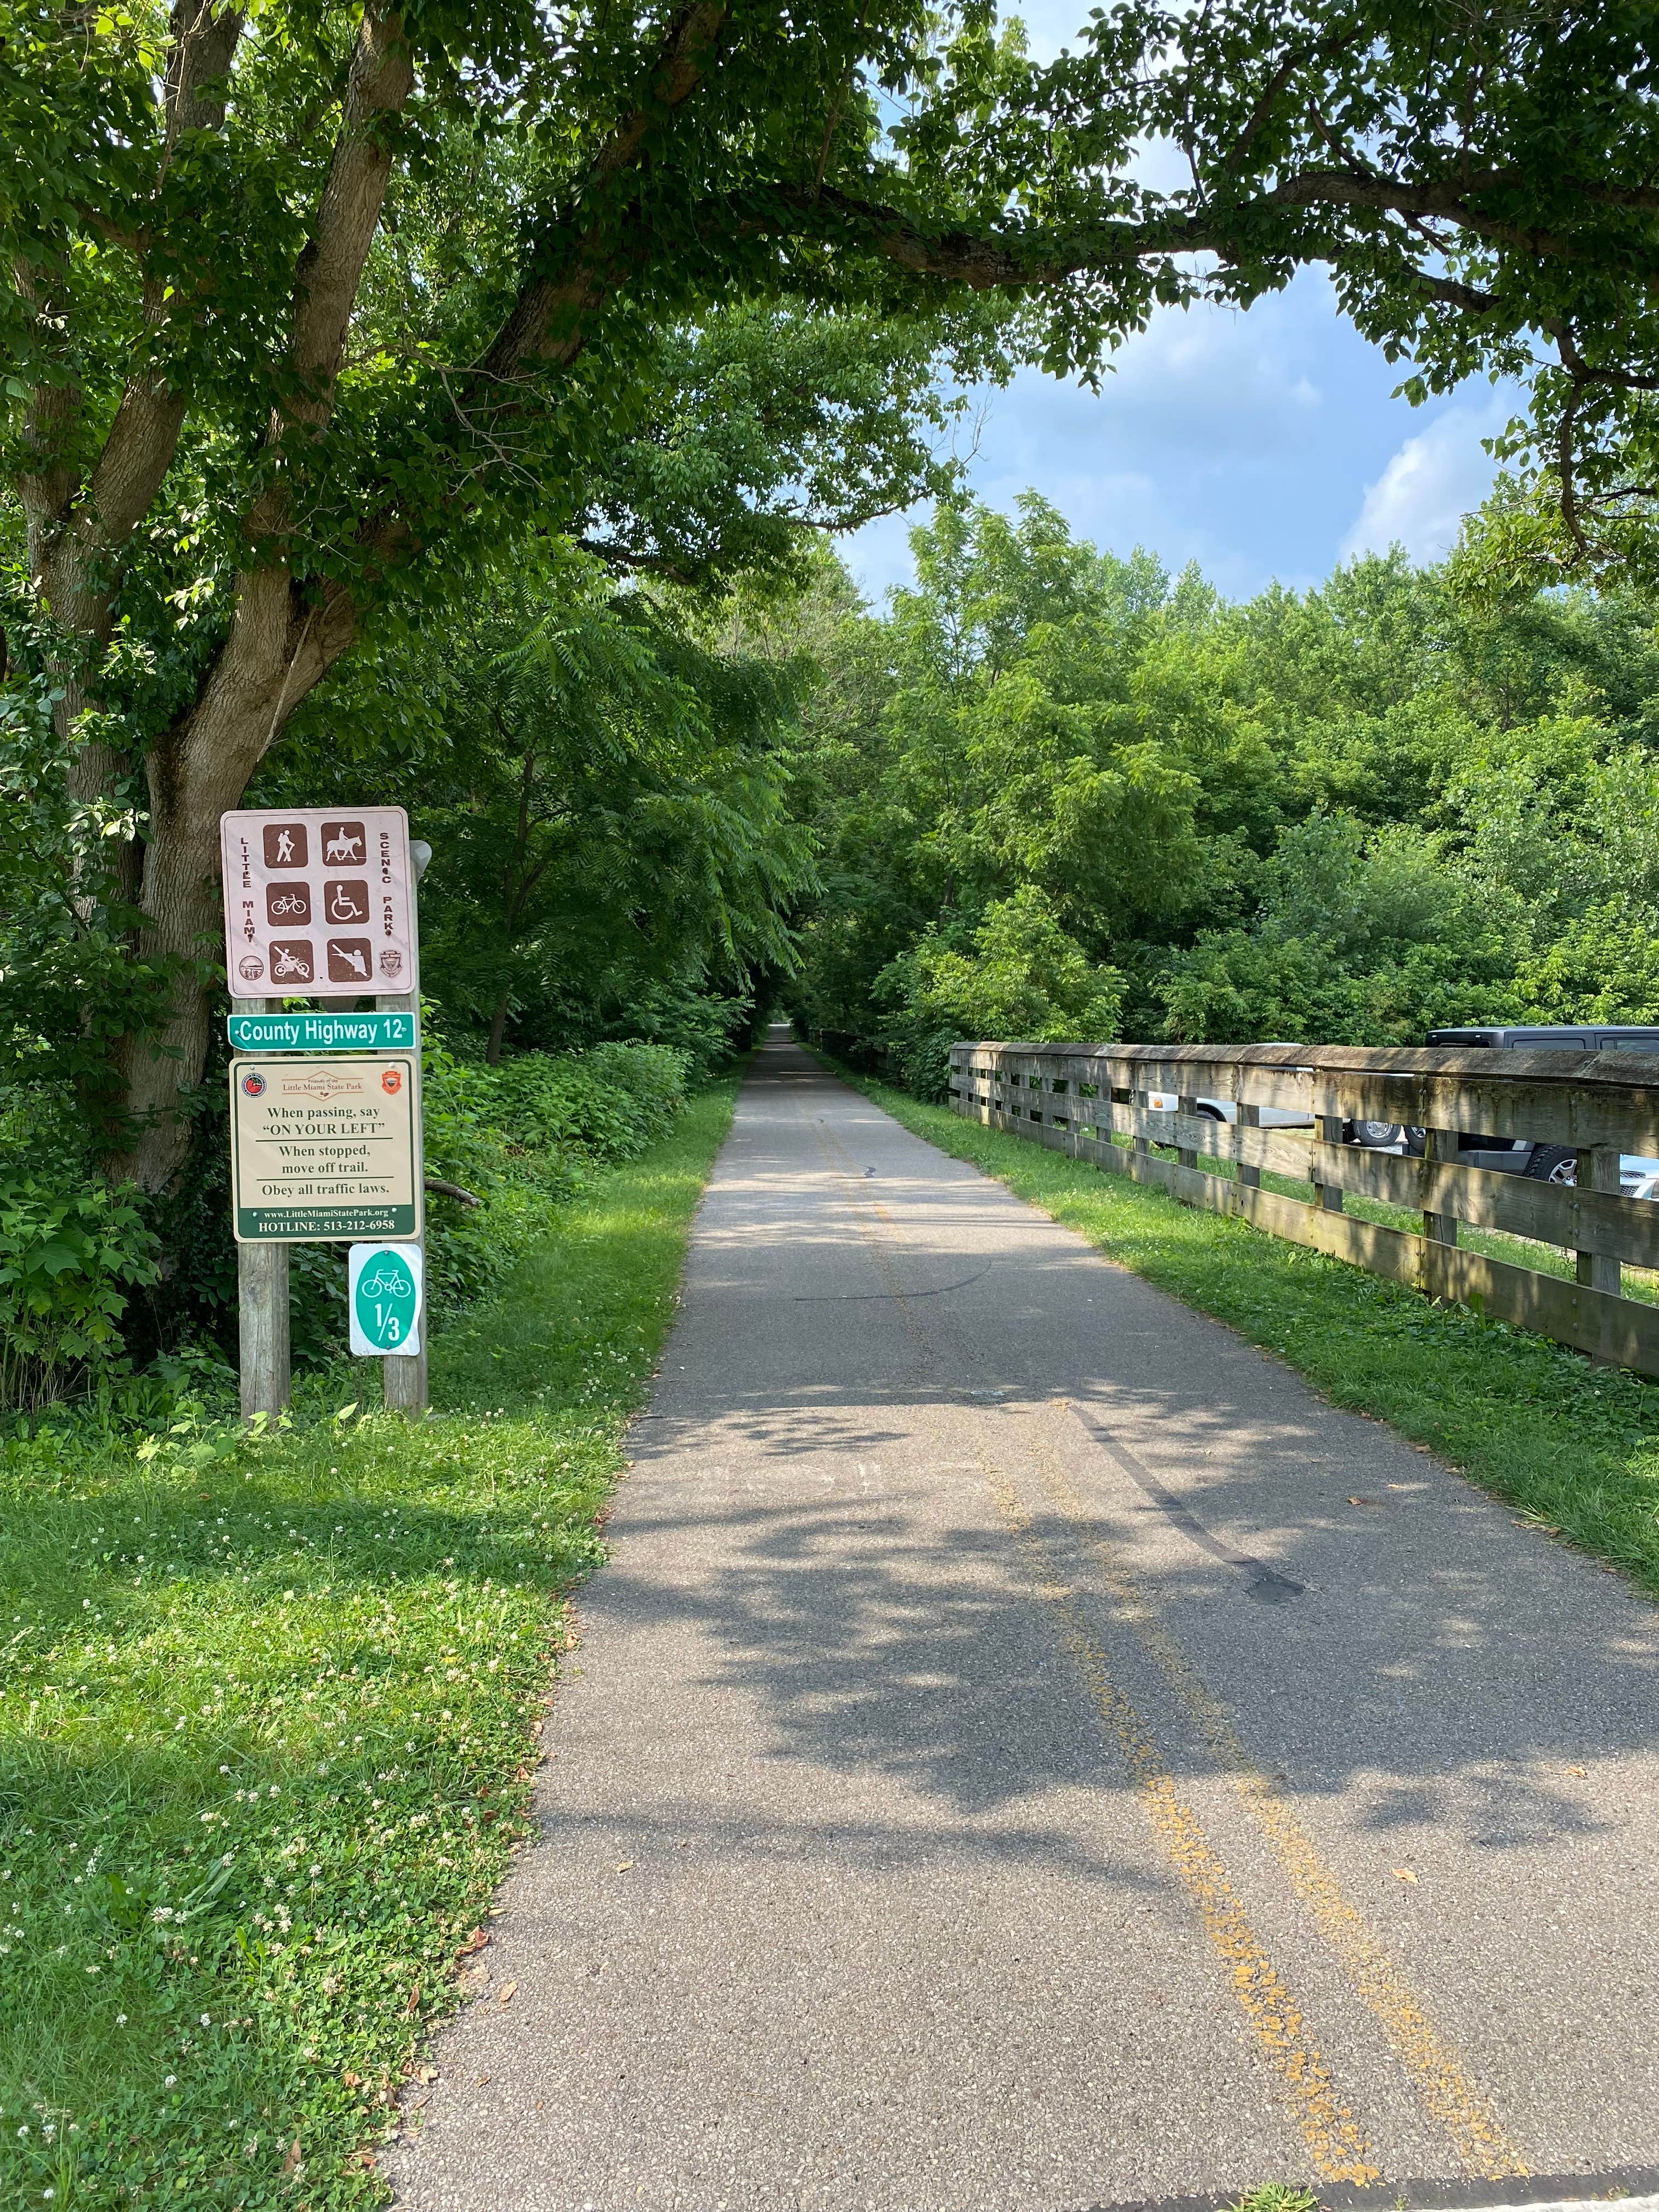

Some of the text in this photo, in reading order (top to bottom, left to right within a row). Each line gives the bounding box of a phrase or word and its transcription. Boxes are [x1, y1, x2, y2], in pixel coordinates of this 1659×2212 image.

[240, 837, 252, 888] LITTLE
[383, 896, 394, 930] PARK
[240, 1018, 403, 1045] County Highway 12
[267, 1107, 380, 1120] When passing, say
[263, 1122, 385, 1136] “ON YOUR LEFT”
[279, 1144, 370, 1159] When stopped,
[318, 1163, 336, 1173] off
[338, 1161, 368, 1172] trail.
[262, 1183, 390, 1198] Obey all traffic laws.
[264, 1209, 389, 1218] www.LittleMiamiStatePark.org
[259, 1220, 395, 1232] HOTLINE: 513-212-6958
